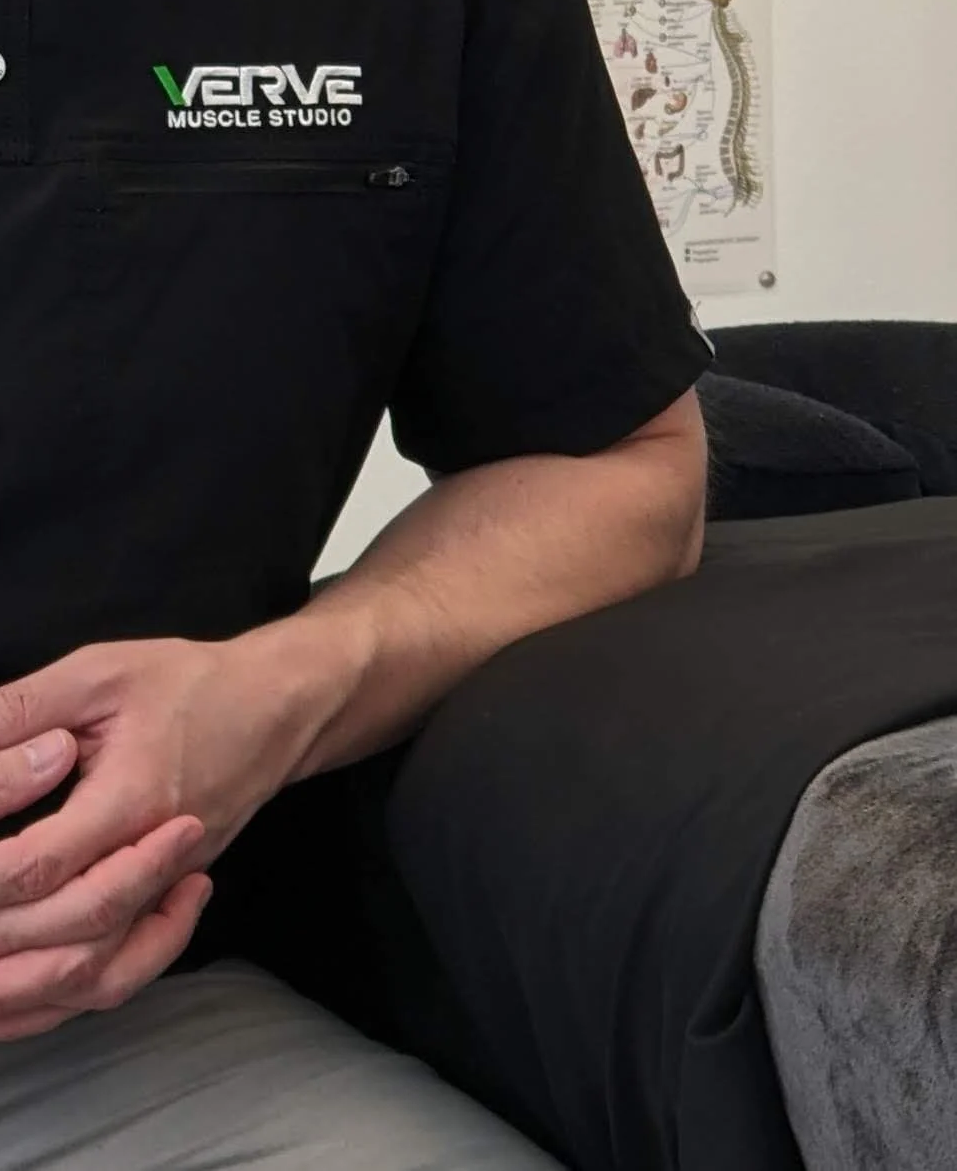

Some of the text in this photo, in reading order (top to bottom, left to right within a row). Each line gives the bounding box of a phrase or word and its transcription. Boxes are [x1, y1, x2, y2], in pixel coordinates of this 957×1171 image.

[152, 64, 364, 107] VERVE
[167, 108, 353, 129] MUSCLE STUDIO
